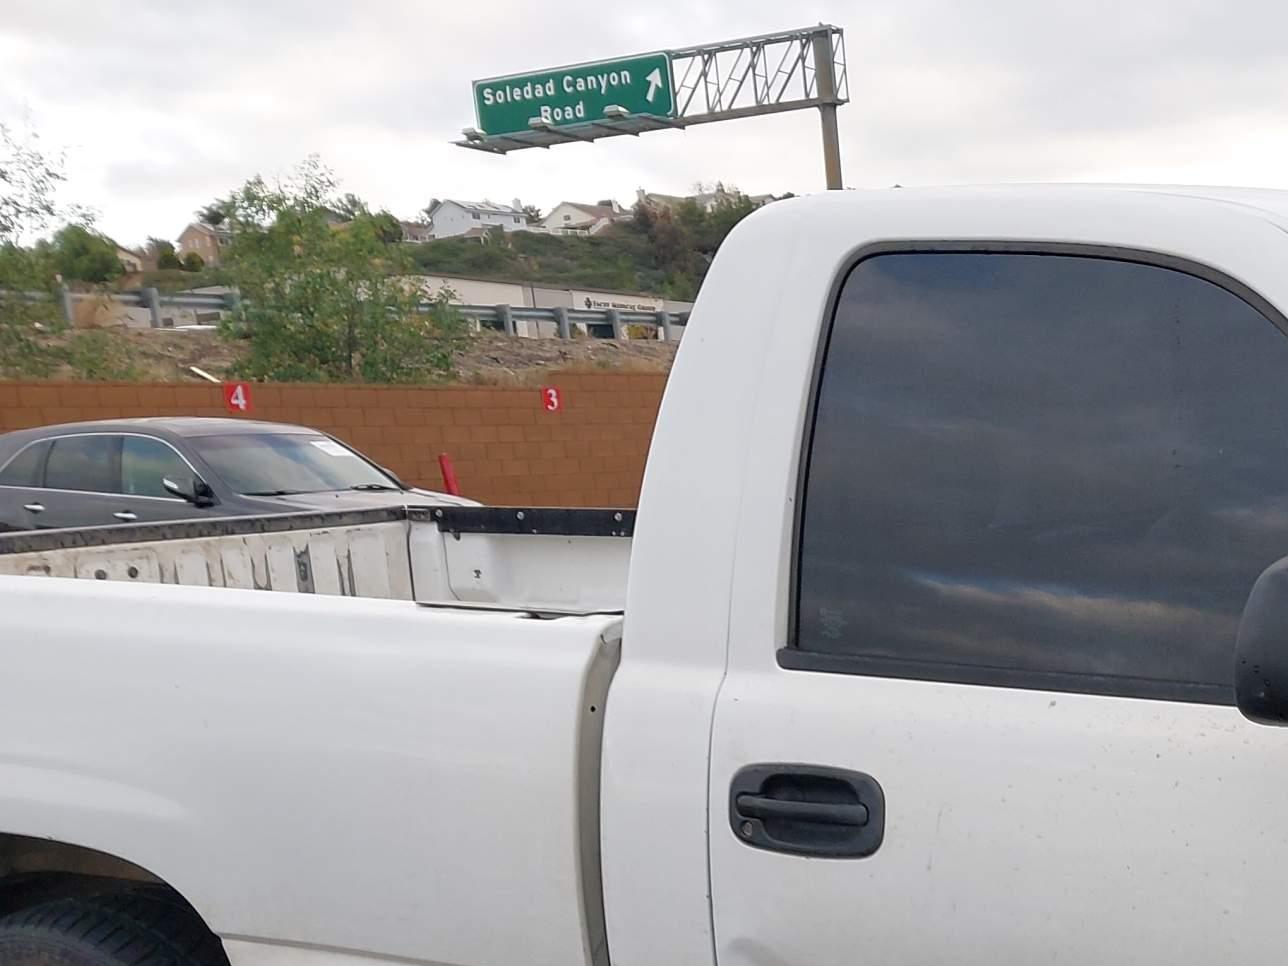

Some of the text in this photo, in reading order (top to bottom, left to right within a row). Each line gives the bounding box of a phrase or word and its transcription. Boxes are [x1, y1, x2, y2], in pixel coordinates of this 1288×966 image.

[483, 70, 631, 105] Soledad Canyon
[540, 101, 585, 121] Road
[231, 384, 247, 410] 4
[546, 388, 558, 410] 3
